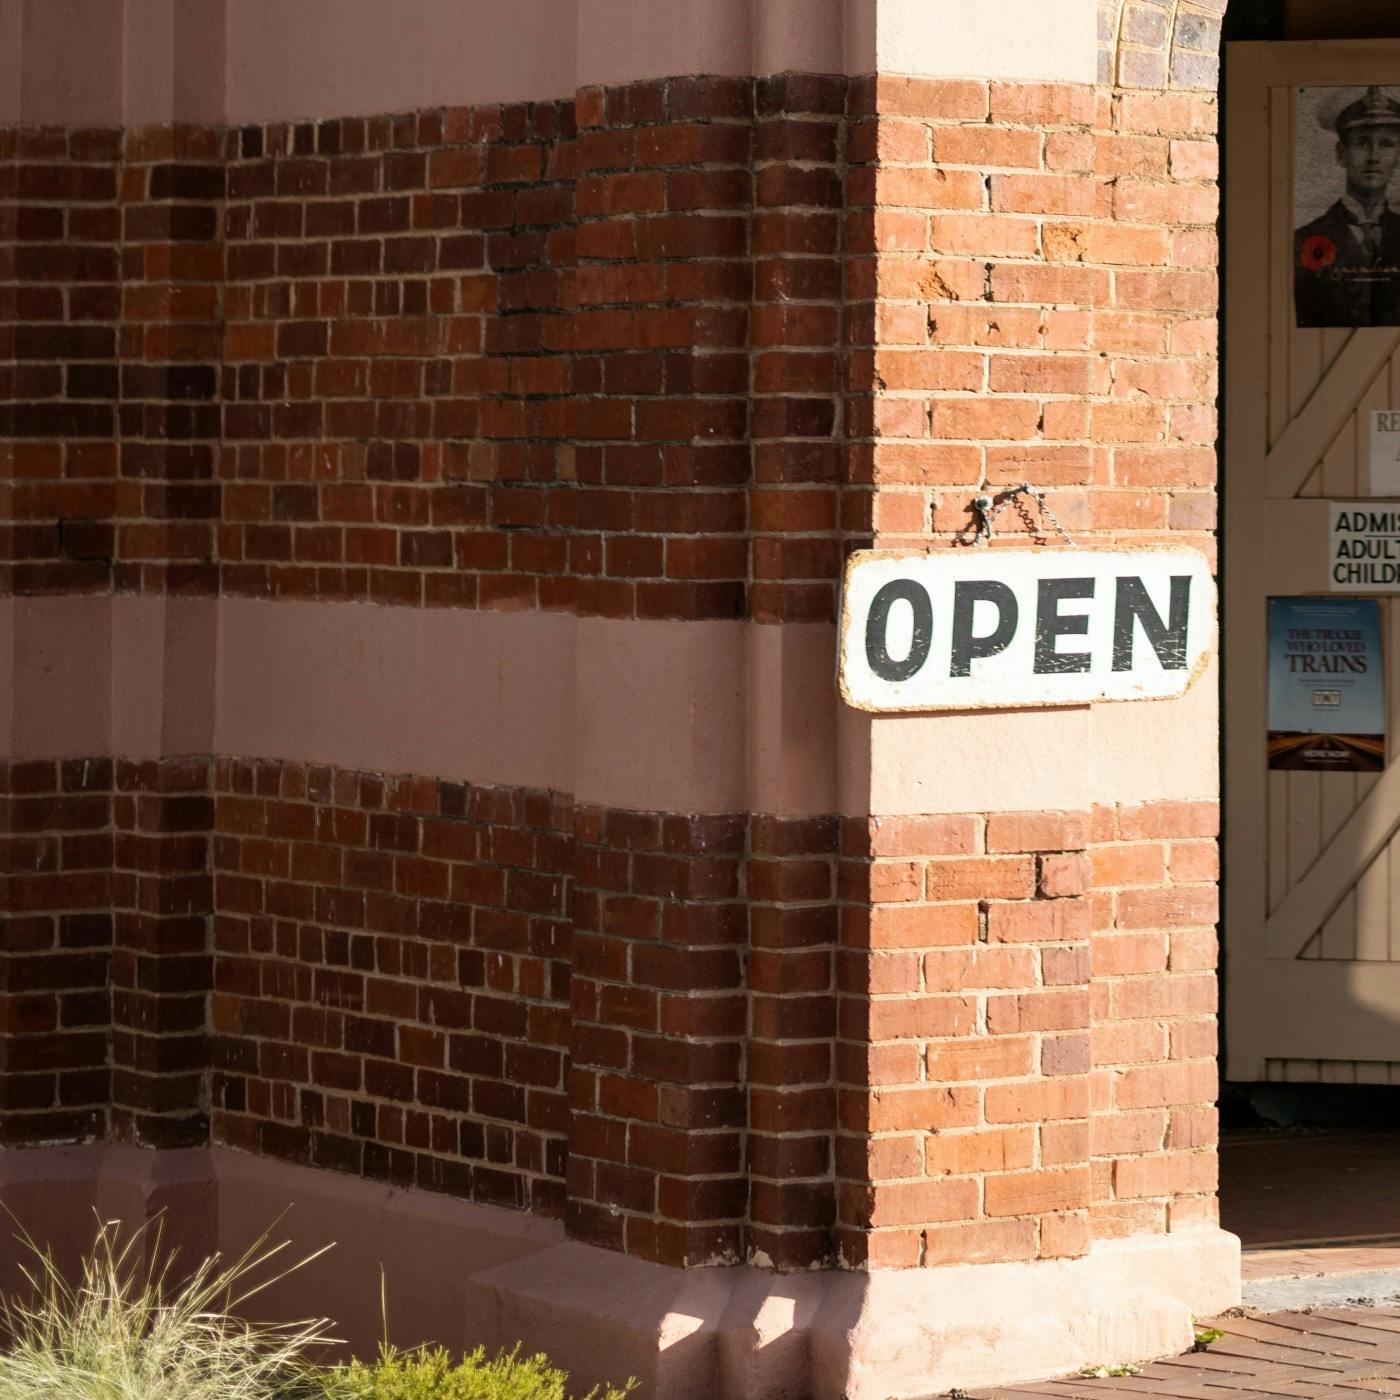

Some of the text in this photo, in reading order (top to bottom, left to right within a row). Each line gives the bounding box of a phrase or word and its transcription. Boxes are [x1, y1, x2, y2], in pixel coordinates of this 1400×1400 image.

[865, 574, 1193, 682] OPEN
[1286, 641, 1367, 653] WHO LOVED
[1285, 654, 1367, 673] TRAINS
